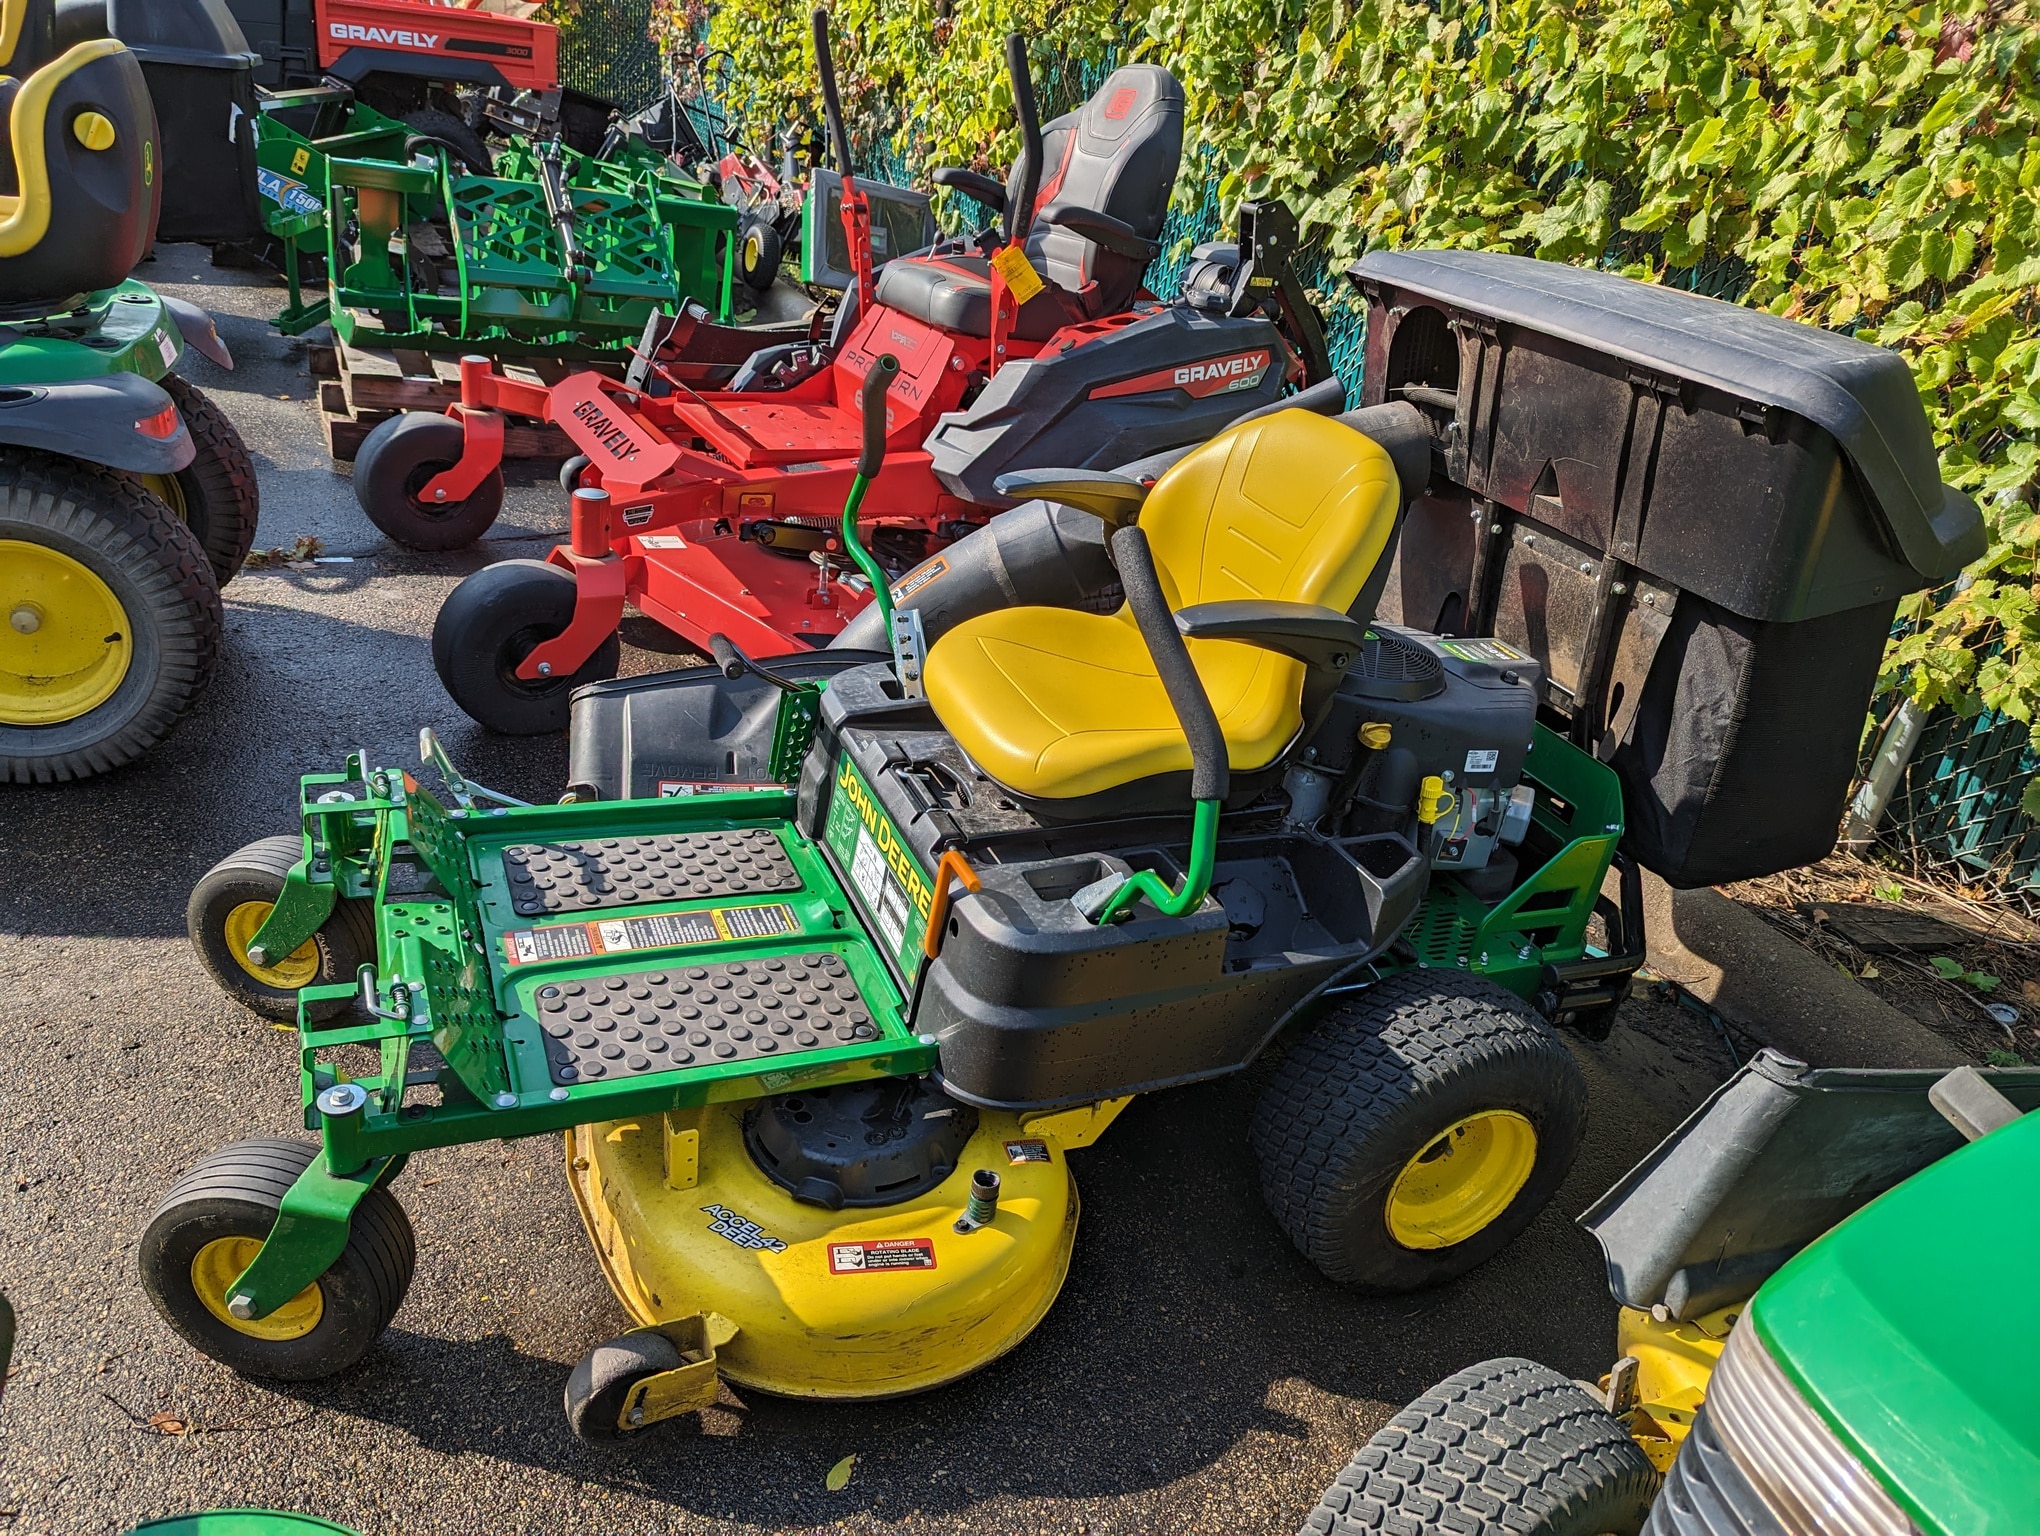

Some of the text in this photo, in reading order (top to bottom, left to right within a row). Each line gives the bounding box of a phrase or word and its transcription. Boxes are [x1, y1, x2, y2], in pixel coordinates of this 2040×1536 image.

[330, 23, 438, 48] GRAVELY
[506, 47, 528, 56] 3000
[1174, 355, 1262, 384] GRAVELY
[1228, 375, 1259, 389] 600
[573, 400, 641, 461] GRAVELY
[642, 762, 719, 779] REMOVE
[839, 761, 877, 835] JOHN
[877, 815, 933, 921] DEERE
[700, 1204, 765, 1240] ACCEL
[707, 1220, 788, 1254] DEEP 42
